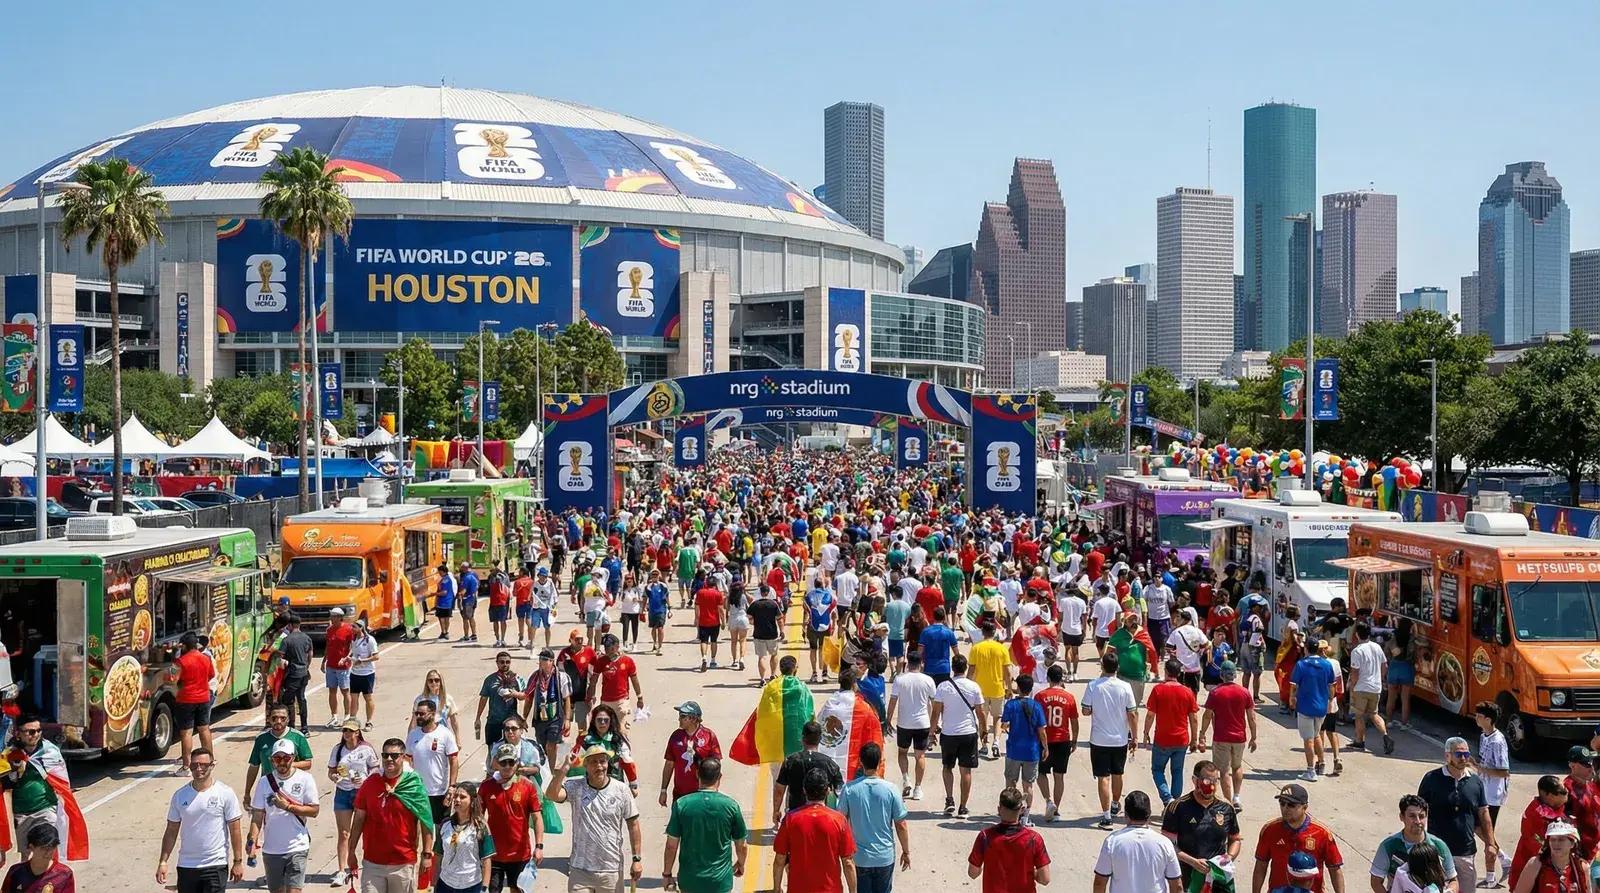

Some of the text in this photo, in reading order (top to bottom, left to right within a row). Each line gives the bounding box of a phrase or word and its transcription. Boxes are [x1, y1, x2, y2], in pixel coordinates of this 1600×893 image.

[484, 158, 519, 167] FIFA
[356, 248, 546, 267] FIFA WORLD CUP 26
[367, 273, 540, 305] HOUSTON
[730, 379, 851, 399] nrg stadium
[766, 407, 838, 419] nrg stadium
[1046, 704, 1063, 728] 18
